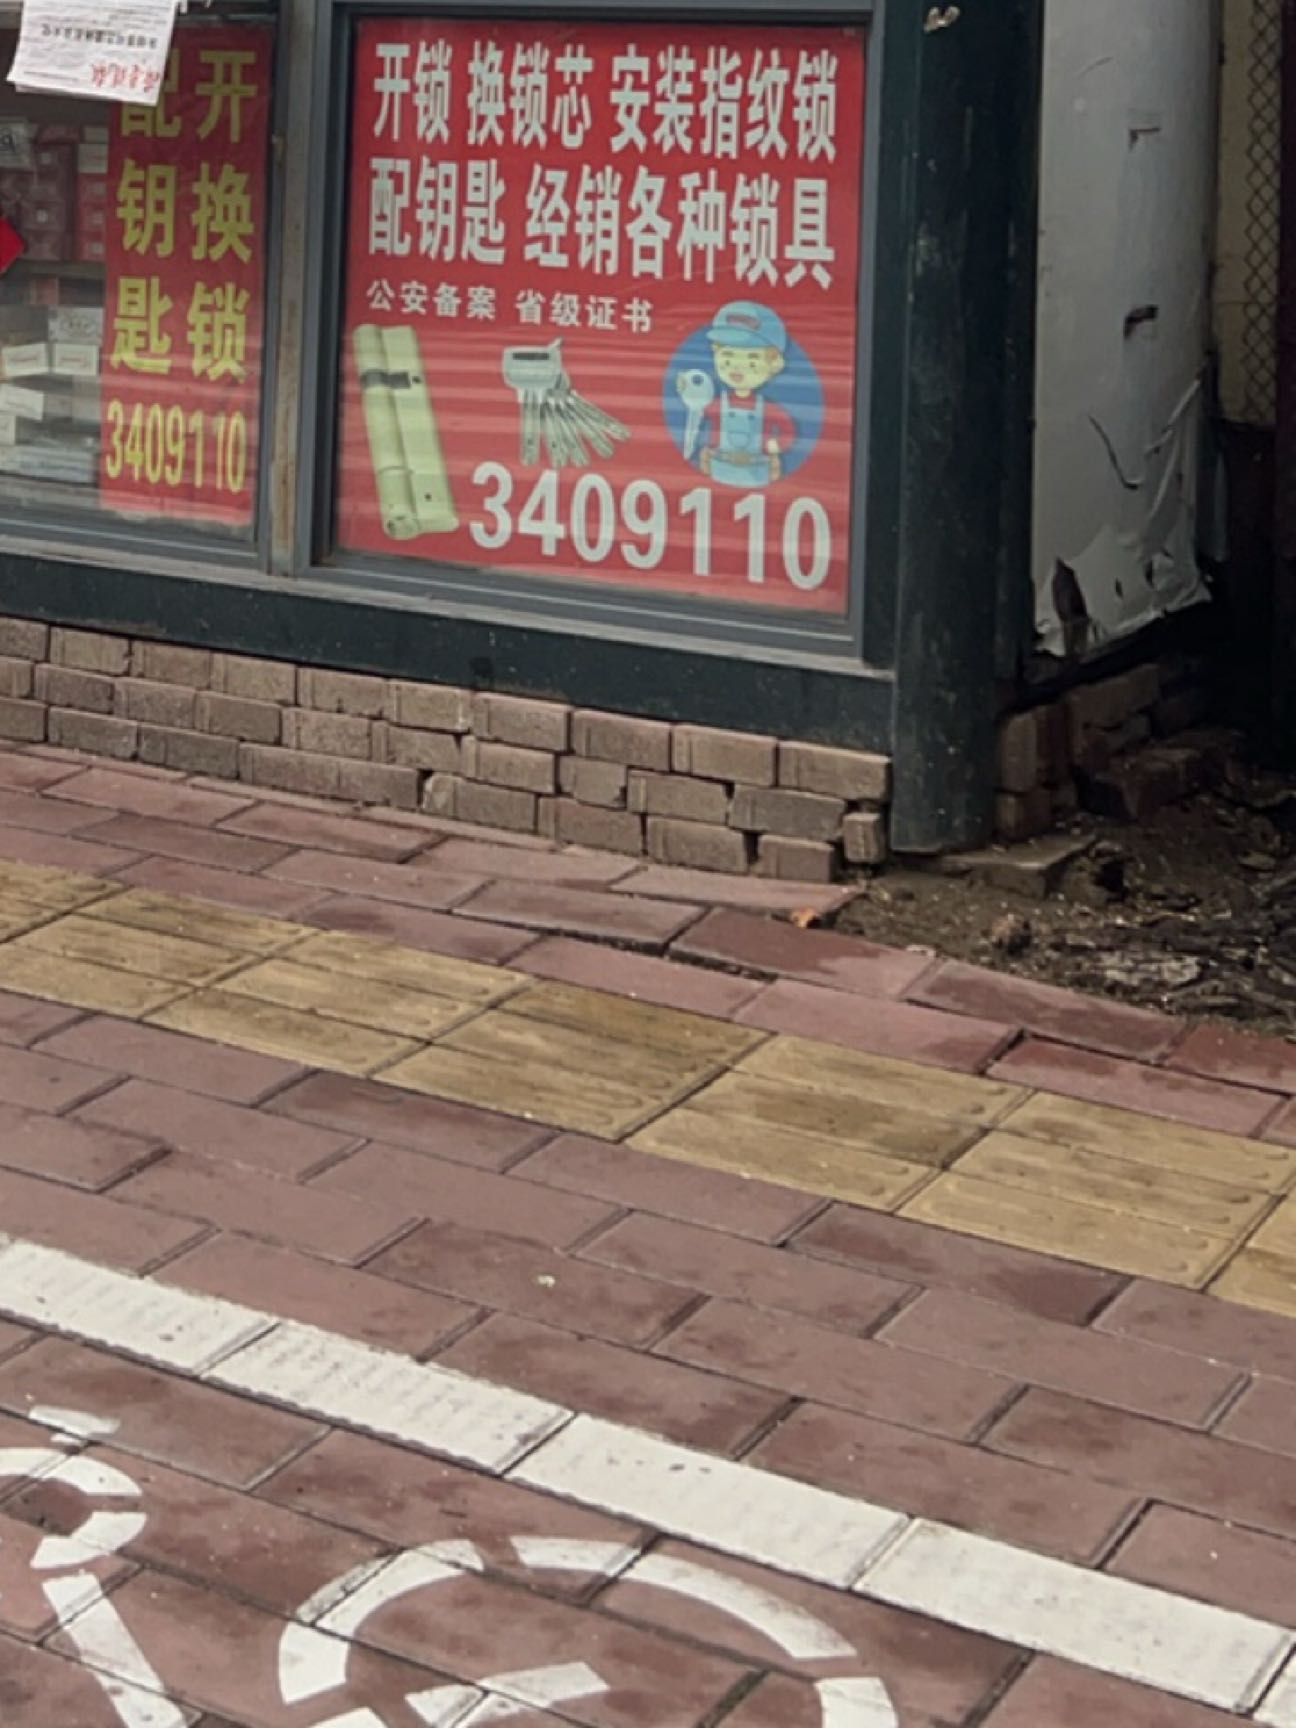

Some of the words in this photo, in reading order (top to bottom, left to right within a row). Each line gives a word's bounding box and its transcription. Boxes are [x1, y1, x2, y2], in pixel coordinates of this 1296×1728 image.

[373, 39, 453, 145] 开锁
[466, 40, 593, 150] 换锁芯
[608, 44, 839, 162] 安装指纹锁
[186, 49, 258, 384] 开换锁
[367, 155, 506, 266] 配钥匙
[523, 164, 837, 290] 经销各种锁具
[365, 278, 498, 321] 公安备案
[514, 288, 654, 335] 省级证书
[102, 399, 247, 493] 3409110
[468, 460, 832, 592] 3409110
